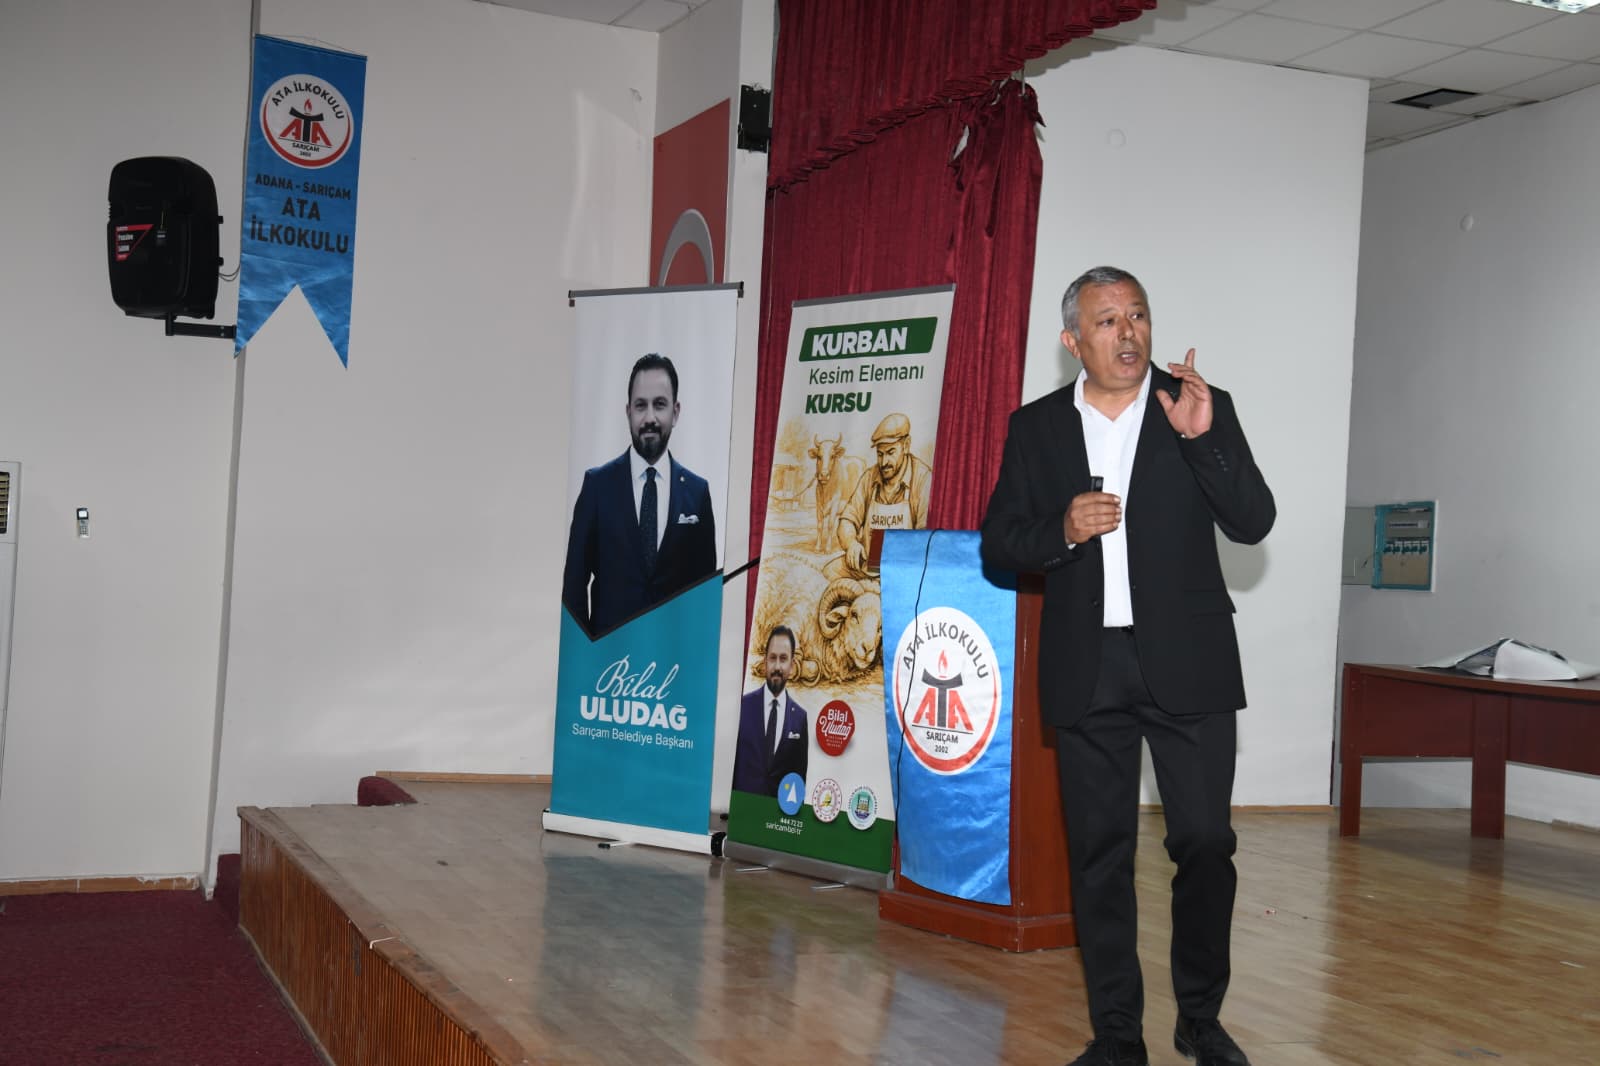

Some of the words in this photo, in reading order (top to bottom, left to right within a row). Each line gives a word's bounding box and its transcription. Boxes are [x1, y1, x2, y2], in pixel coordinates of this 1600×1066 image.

[271, 86, 292, 107] ATA
[294, 80, 345, 120] İLKOKULU
[279, 106, 332, 147] ATA
[292, 142, 320, 153] SARIÇAM
[255, 173, 293, 191] ADANA
[303, 181, 351, 200] SARIÇAM
[282, 197, 321, 221] ATA
[251, 215, 349, 254] İLKOKULU
[811, 327, 908, 357] KURBAN
[809, 366, 854, 385] Kesim
[859, 364, 924, 382] Elemanı
[805, 391, 872, 414] KURSU
[871, 514, 904, 528] SARIÇAM
[903, 635, 925, 670] ATA
[924, 622, 989, 679] İLKOKULU
[596, 654, 680, 700] Bilal
[580, 695, 688, 731] ULUDAĞ
[912, 668, 975, 731] ATA
[828, 709, 848, 722] Bilal
[572, 723, 609, 739] Sarıçam
[612, 728, 653, 746] Belediye
[656, 733, 694, 750] Başkanı
[926, 730, 959, 745] SARIÇAM
[934, 744, 949, 754] 2002
